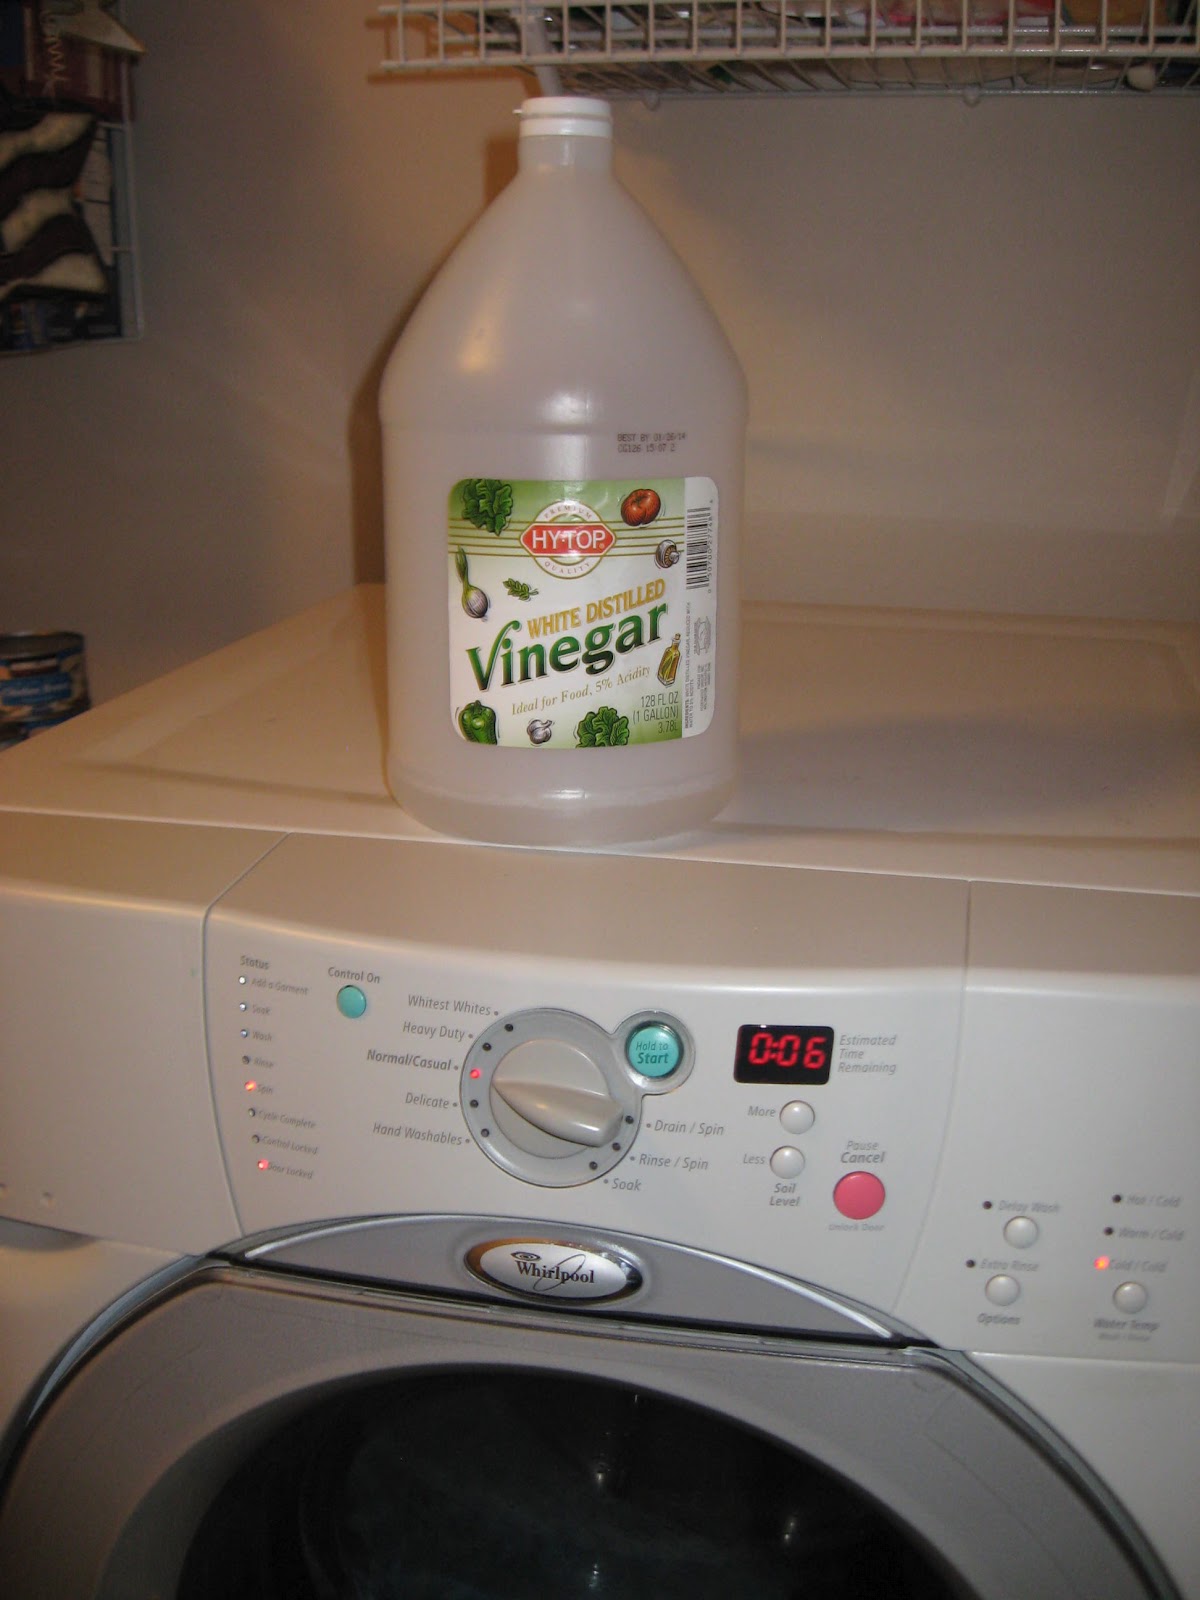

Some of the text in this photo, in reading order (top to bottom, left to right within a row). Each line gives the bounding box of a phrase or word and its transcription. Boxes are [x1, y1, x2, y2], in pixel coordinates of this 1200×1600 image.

[617, 433, 636, 442] BEST
[640, 433, 648, 442] BY
[544, 505, 592, 519] PREMIUM
[545, 561, 590, 574] QUALITY
[527, 578, 666, 639] WHITE DISTILLED
[466, 602, 668, 692] Vinegar
[512, 666, 651, 716] Ideal for Food, 5% Acidity
[640, 691, 679, 708] 128 FL OZ
[632, 704, 679, 725] (1 GALLON)
[240, 955, 270, 971] Status
[328, 966, 381, 984] Control On
[276, 982, 308, 996] Garment
[252, 1004, 270, 1016] Soak
[408, 994, 492, 1016] Whitest Whites
[252, 1031, 272, 1042] Wash
[402, 1021, 466, 1042] Heavy Duty
[636, 1041, 668, 1052] Hold to
[839, 1034, 897, 1046] Estimated
[637, 1052, 669, 1064] Start
[748, 1032, 828, 1070] 0:06
[839, 1048, 865, 1060] Time
[366, 1049, 452, 1072] Normal/Casual
[837, 1062, 898, 1076] Remaining
[257, 1084, 274, 1096] Spin
[404, 1092, 450, 1109] Delicate
[748, 1105, 776, 1118] More
[280, 1114, 317, 1130] Complete
[654, 1120, 690, 1134] Drain
[698, 1122, 725, 1136] Spin
[372, 1122, 462, 1146] Hand Washables
[263, 1136, 290, 1150] Control
[846, 1140, 879, 1151] Pause
[639, 1153, 672, 1168] Rinse
[682, 1156, 709, 1171] Spin
[743, 1153, 766, 1165] Less
[840, 1152, 886, 1164] Cancel
[612, 1178, 642, 1192] Soak
[774, 1182, 796, 1194] Soil
[769, 1196, 802, 1207] Level
[514, 1260, 595, 1284] Whirlpool
[977, 1312, 1022, 1326] Options
